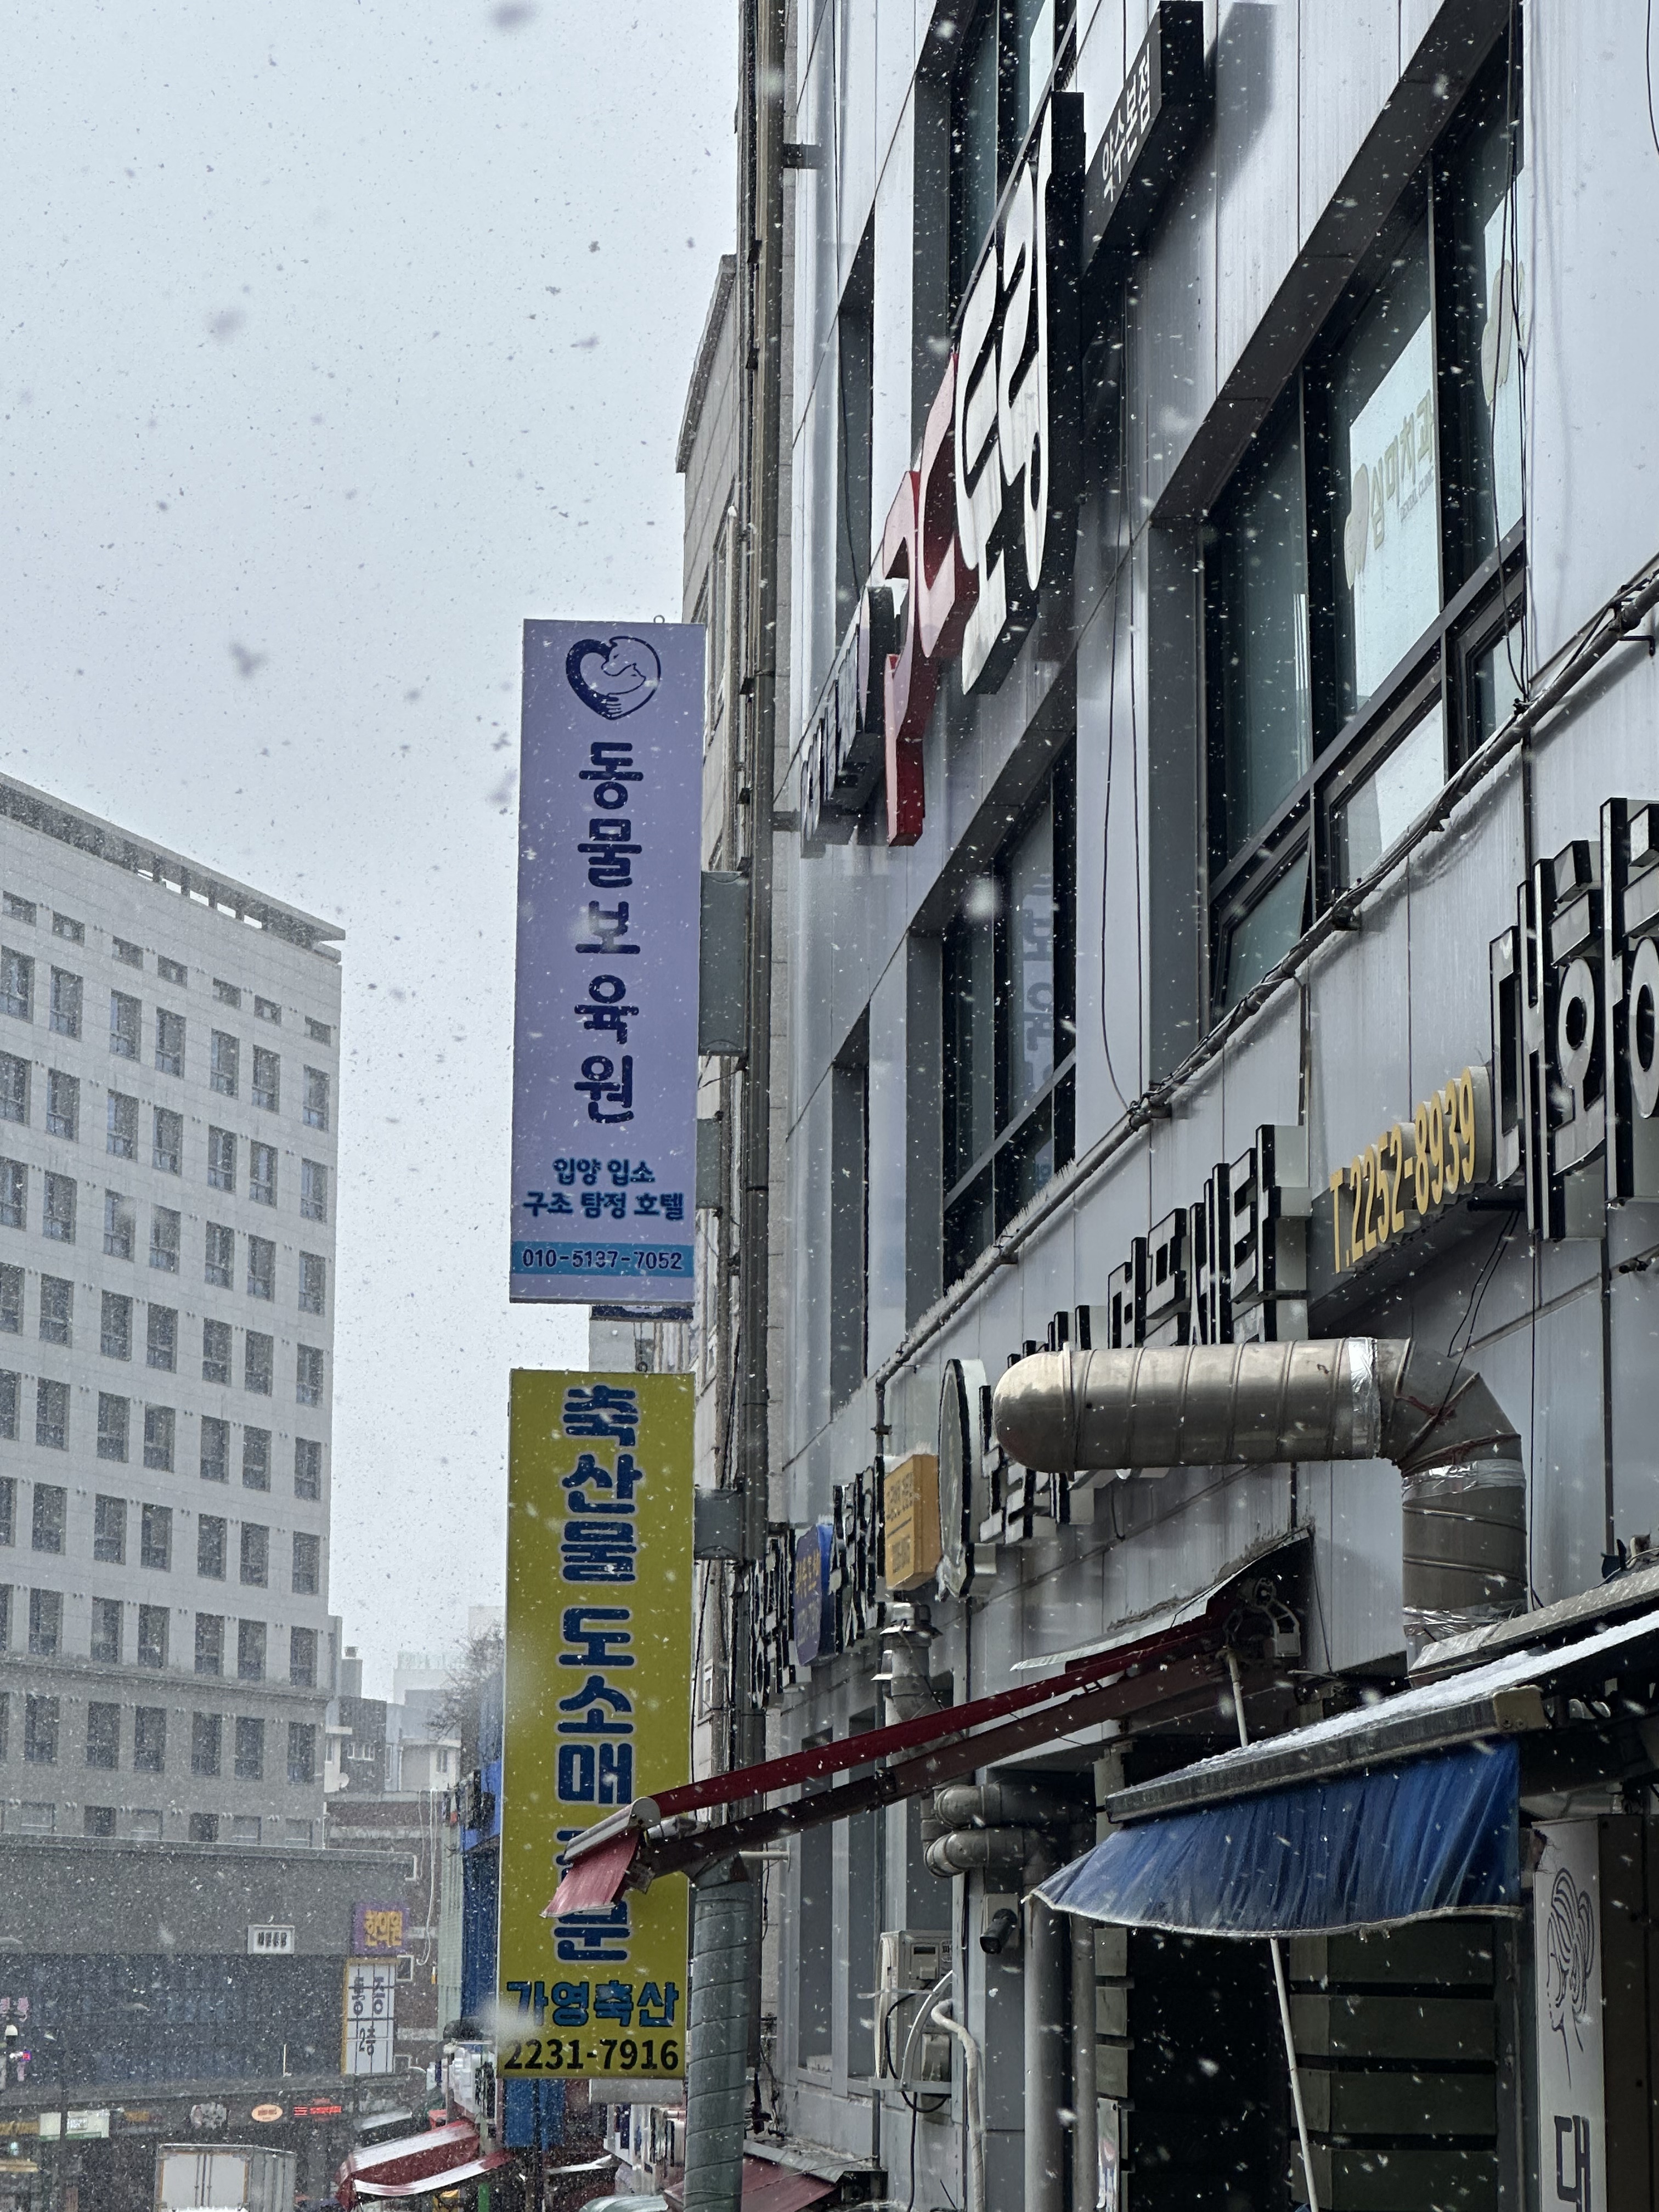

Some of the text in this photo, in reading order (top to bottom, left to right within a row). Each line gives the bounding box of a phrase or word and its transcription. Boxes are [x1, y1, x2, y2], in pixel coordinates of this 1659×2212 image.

[1102, 42, 1150, 202] 약수본점
[573, 742, 645, 1126] 동물보육원
[552, 1158, 656, 1187] 입양 입소
[1329, 1066, 1476, 1274] T.2252-8939
[522, 1190, 684, 1221] 구조 탐정 호텔
[522, 1248, 683, 1271] 010-5137-7052
[553, 1384, 642, 1962] 축산물 도소매 문
[364, 1910, 403, 1946] 한의원
[506, 1979, 679, 2028] 가영축산
[504, 2038, 679, 2070] 2231-7916
